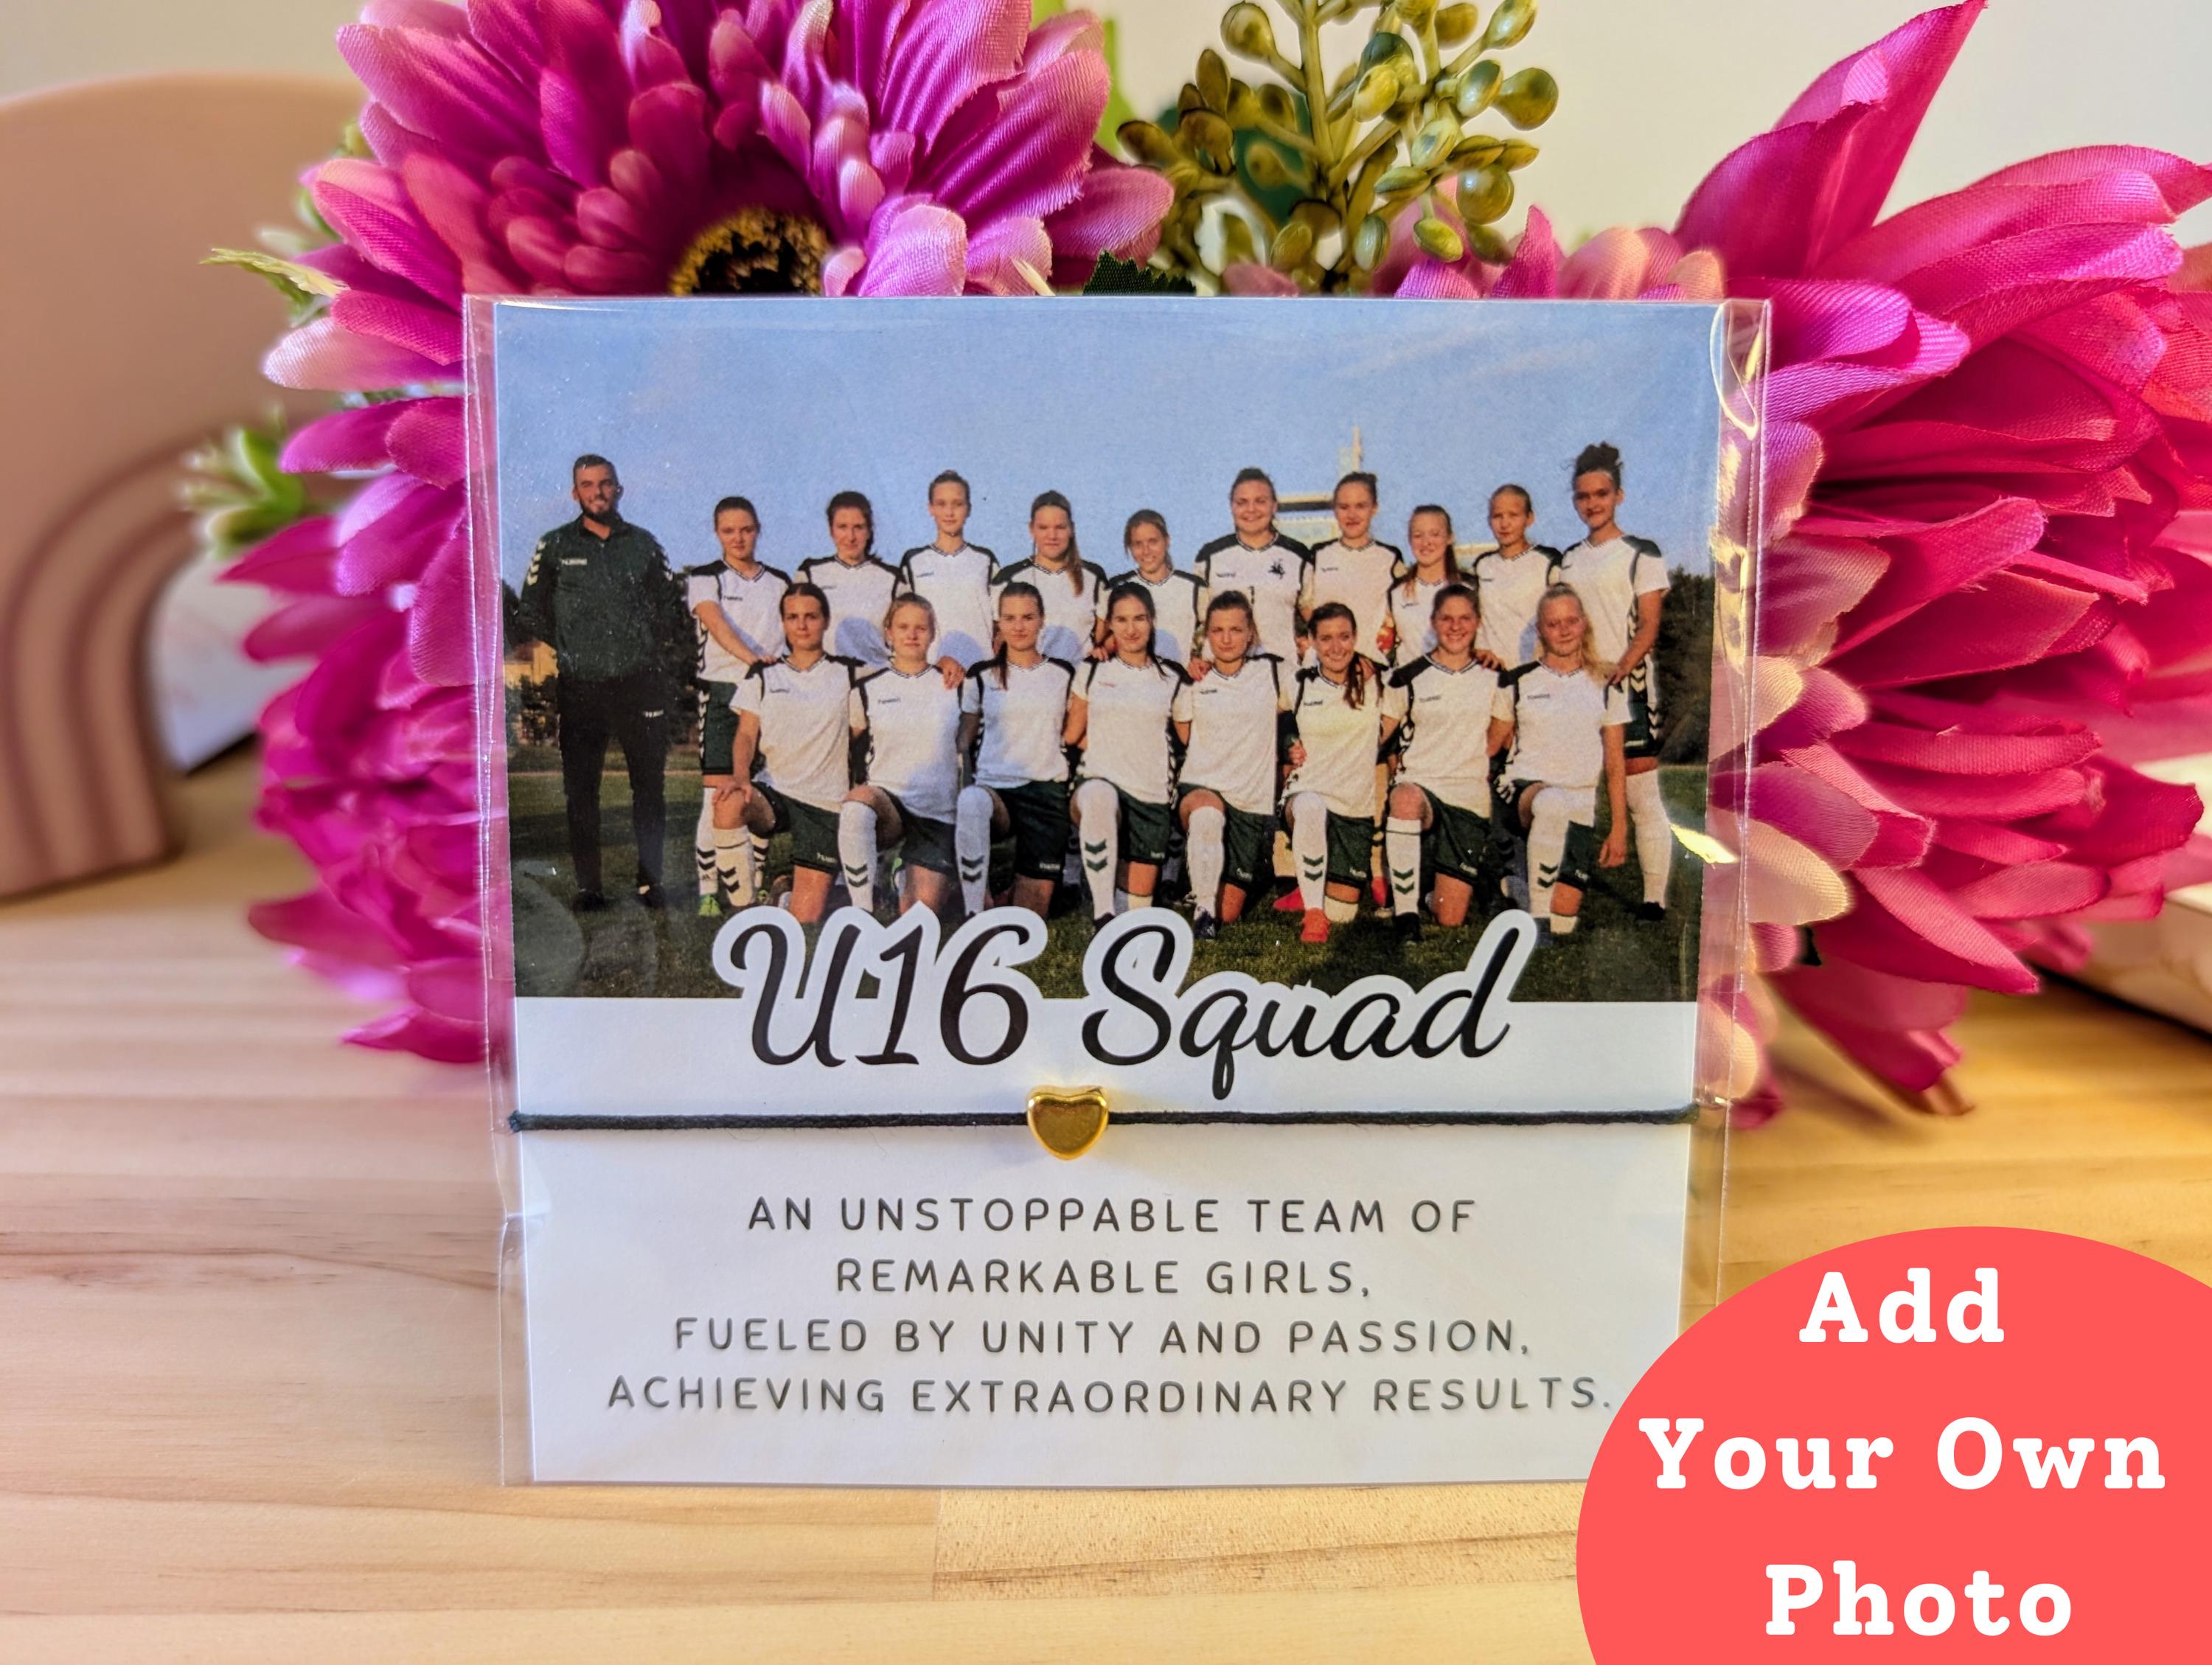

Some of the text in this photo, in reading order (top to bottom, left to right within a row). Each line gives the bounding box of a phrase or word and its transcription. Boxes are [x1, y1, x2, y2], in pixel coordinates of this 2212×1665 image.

[730, 923, 1511, 1100] U16 Squad
[748, 1195, 1475, 1233] AN UNSTOPPABLE TEAM OF
[837, 1258, 1369, 1298] REMARKABLE GIRLS,
[675, 1317, 1529, 1355] FUELED BY UNITY AND PASSION,
[608, 1374, 1611, 1414] ACHIEVING EXTRAORDINARY RESULTS.
